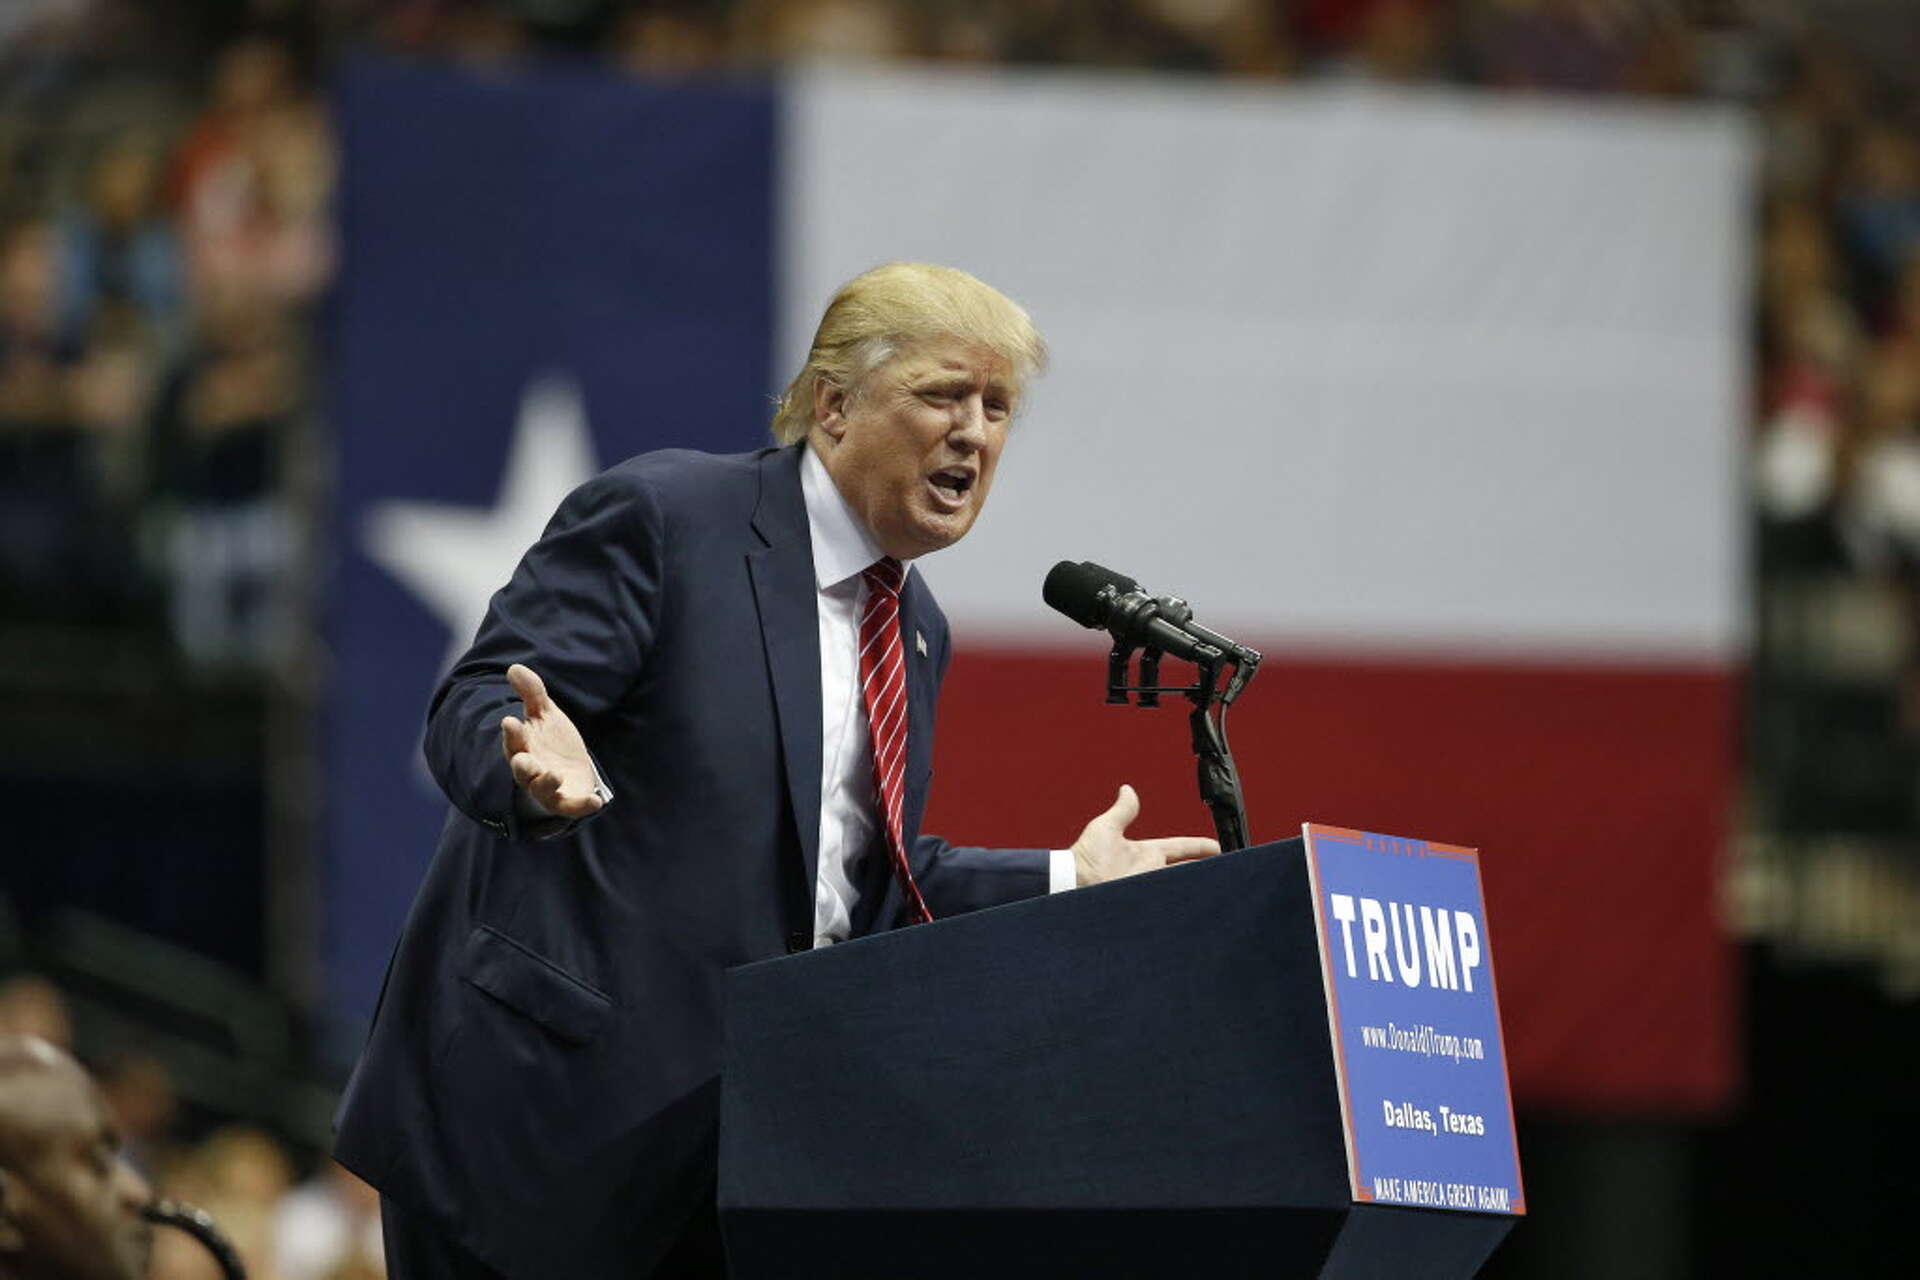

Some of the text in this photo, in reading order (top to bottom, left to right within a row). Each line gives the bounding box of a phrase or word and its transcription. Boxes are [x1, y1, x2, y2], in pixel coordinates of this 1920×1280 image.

[1331, 893, 1480, 993] TRUMP
[1361, 1022, 1484, 1064] www.DonaldJTrump.com
[1383, 1100, 1485, 1136] Dallas, Texas
[1374, 1177, 1511, 1211] MAKE AMERICA GREAT AGAIN!
